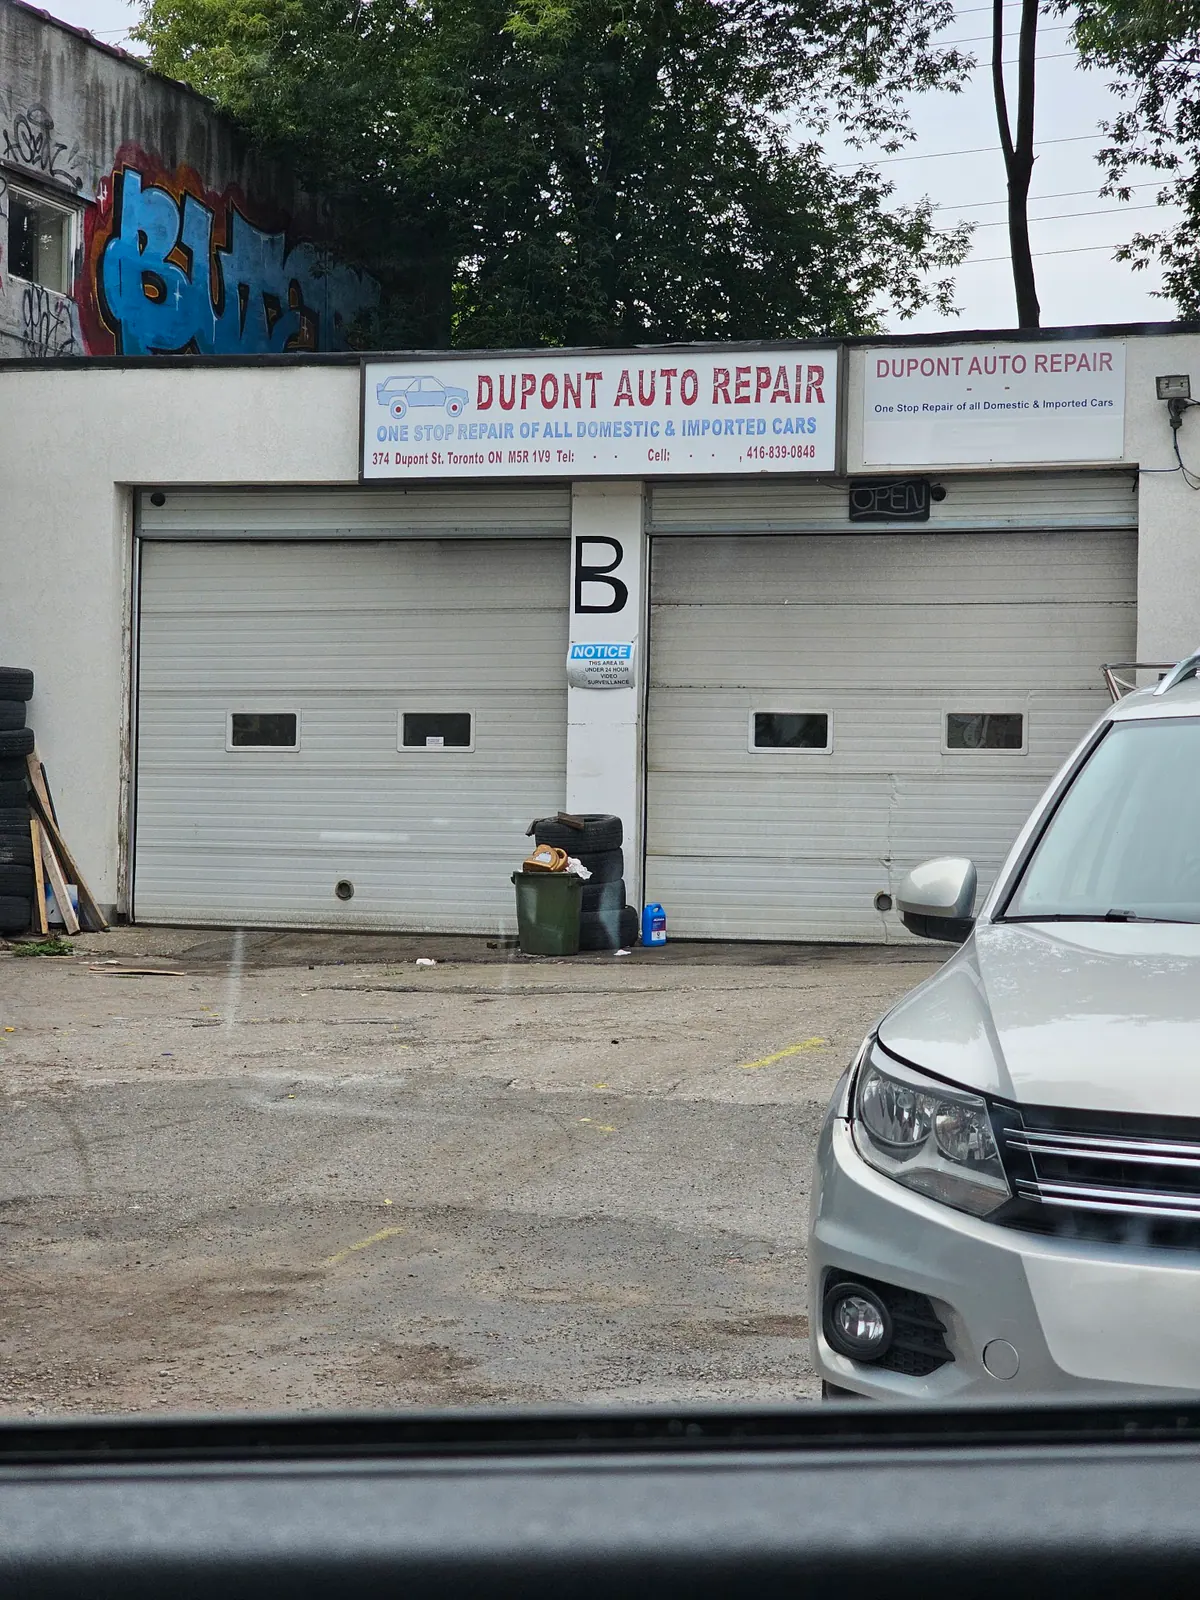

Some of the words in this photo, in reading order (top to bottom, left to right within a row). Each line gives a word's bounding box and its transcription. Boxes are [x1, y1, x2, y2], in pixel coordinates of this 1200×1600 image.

[876, 356, 964, 379] DUPONT
[967, 354, 1027, 376] AUTO
[1034, 352, 1113, 374] REPAIR
[476, 371, 604, 411] DUPONT
[613, 368, 699, 407] AUTO
[712, 364, 826, 405] REPAIR
[874, 403, 894, 413] One
[896, 403, 919, 414] Stop
[922, 402, 953, 413] Repair
[956, 401, 967, 411] of
[969, 401, 981, 411] all
[983, 399, 1030, 410] Domestic
[1032, 399, 1040, 409] &
[1042, 398, 1088, 410] Imported
[1090, 397, 1114, 408] Cars
[376, 424, 409, 442] ONE
[413, 423, 455, 442] STOP
[457, 422, 515, 440] REPAIR
[519, 421, 540, 439] OF
[542, 421, 573, 438] ALL
[576, 419, 660, 438] DOMESTIC
[664, 420, 676, 437] &
[681, 417, 767, 437] IMPORTED
[772, 416, 817, 435] CARS
[372, 452, 390, 466] 374
[395, 451, 429, 468] Dupont
[431, 450, 445, 465] St.
[447, 450, 485, 465] Toronto
[487, 450, 502, 465] ON
[508, 449, 529, 464] M5R
[532, 449, 551, 463] 1V9
[556, 448, 575, 463] Tel:
[647, 447, 670, 462] Cell:
[746, 444, 816, 460] 416-839-0848
[851, 484, 926, 511] OPEN
[574, 535, 629, 614] B
[573, 645, 629, 658] NOTICE
